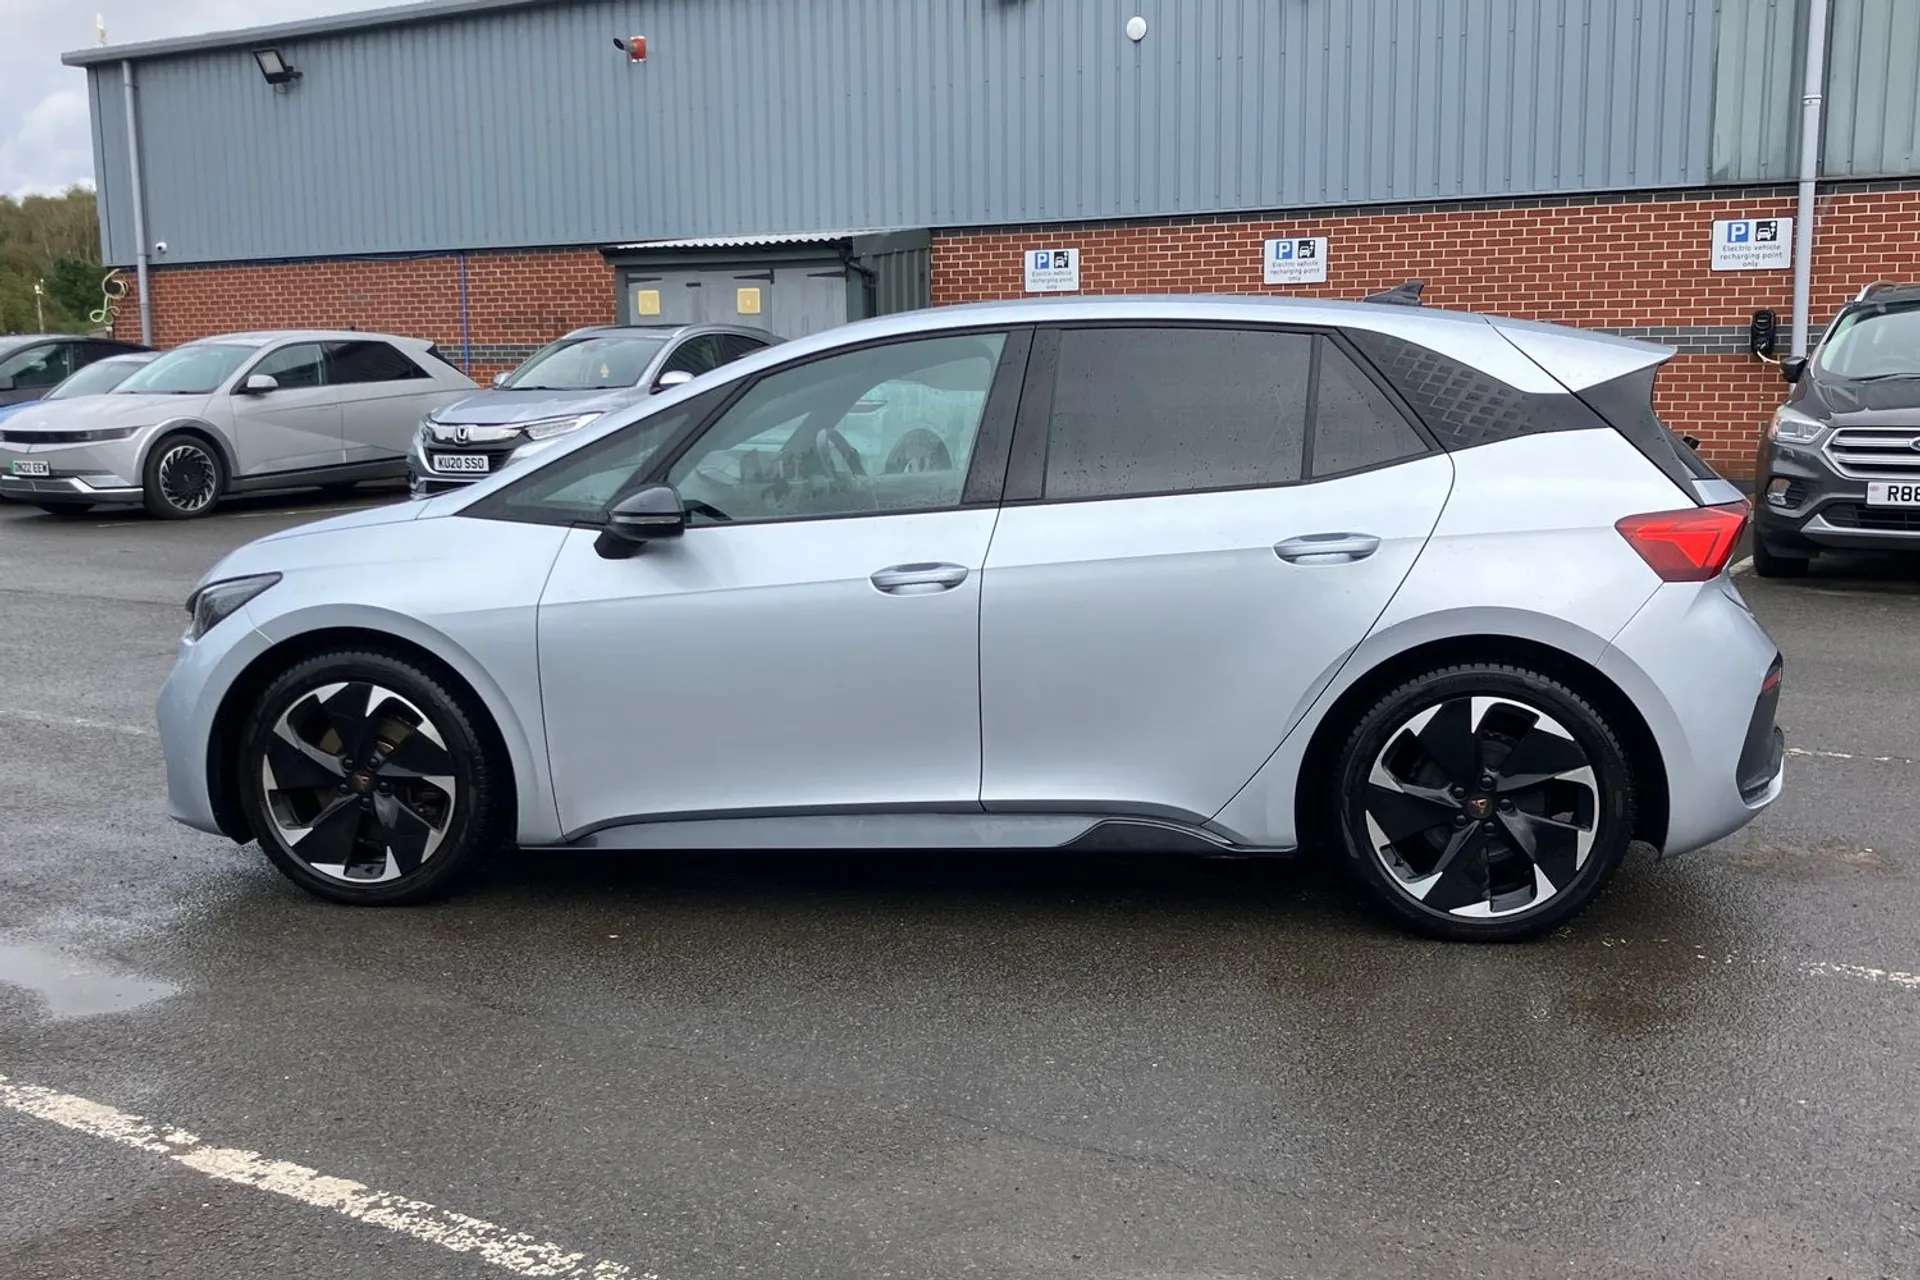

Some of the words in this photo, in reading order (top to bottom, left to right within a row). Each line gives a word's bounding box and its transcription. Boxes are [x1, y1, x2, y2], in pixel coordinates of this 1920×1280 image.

[1730, 223, 1746, 242] P
[1278, 242, 1291, 259] P
[1720, 252, 1760, 260] recharging
[1762, 251, 1782, 260] point
[1722, 244, 1751, 252] Electric
[1037, 253, 1047, 269] P
